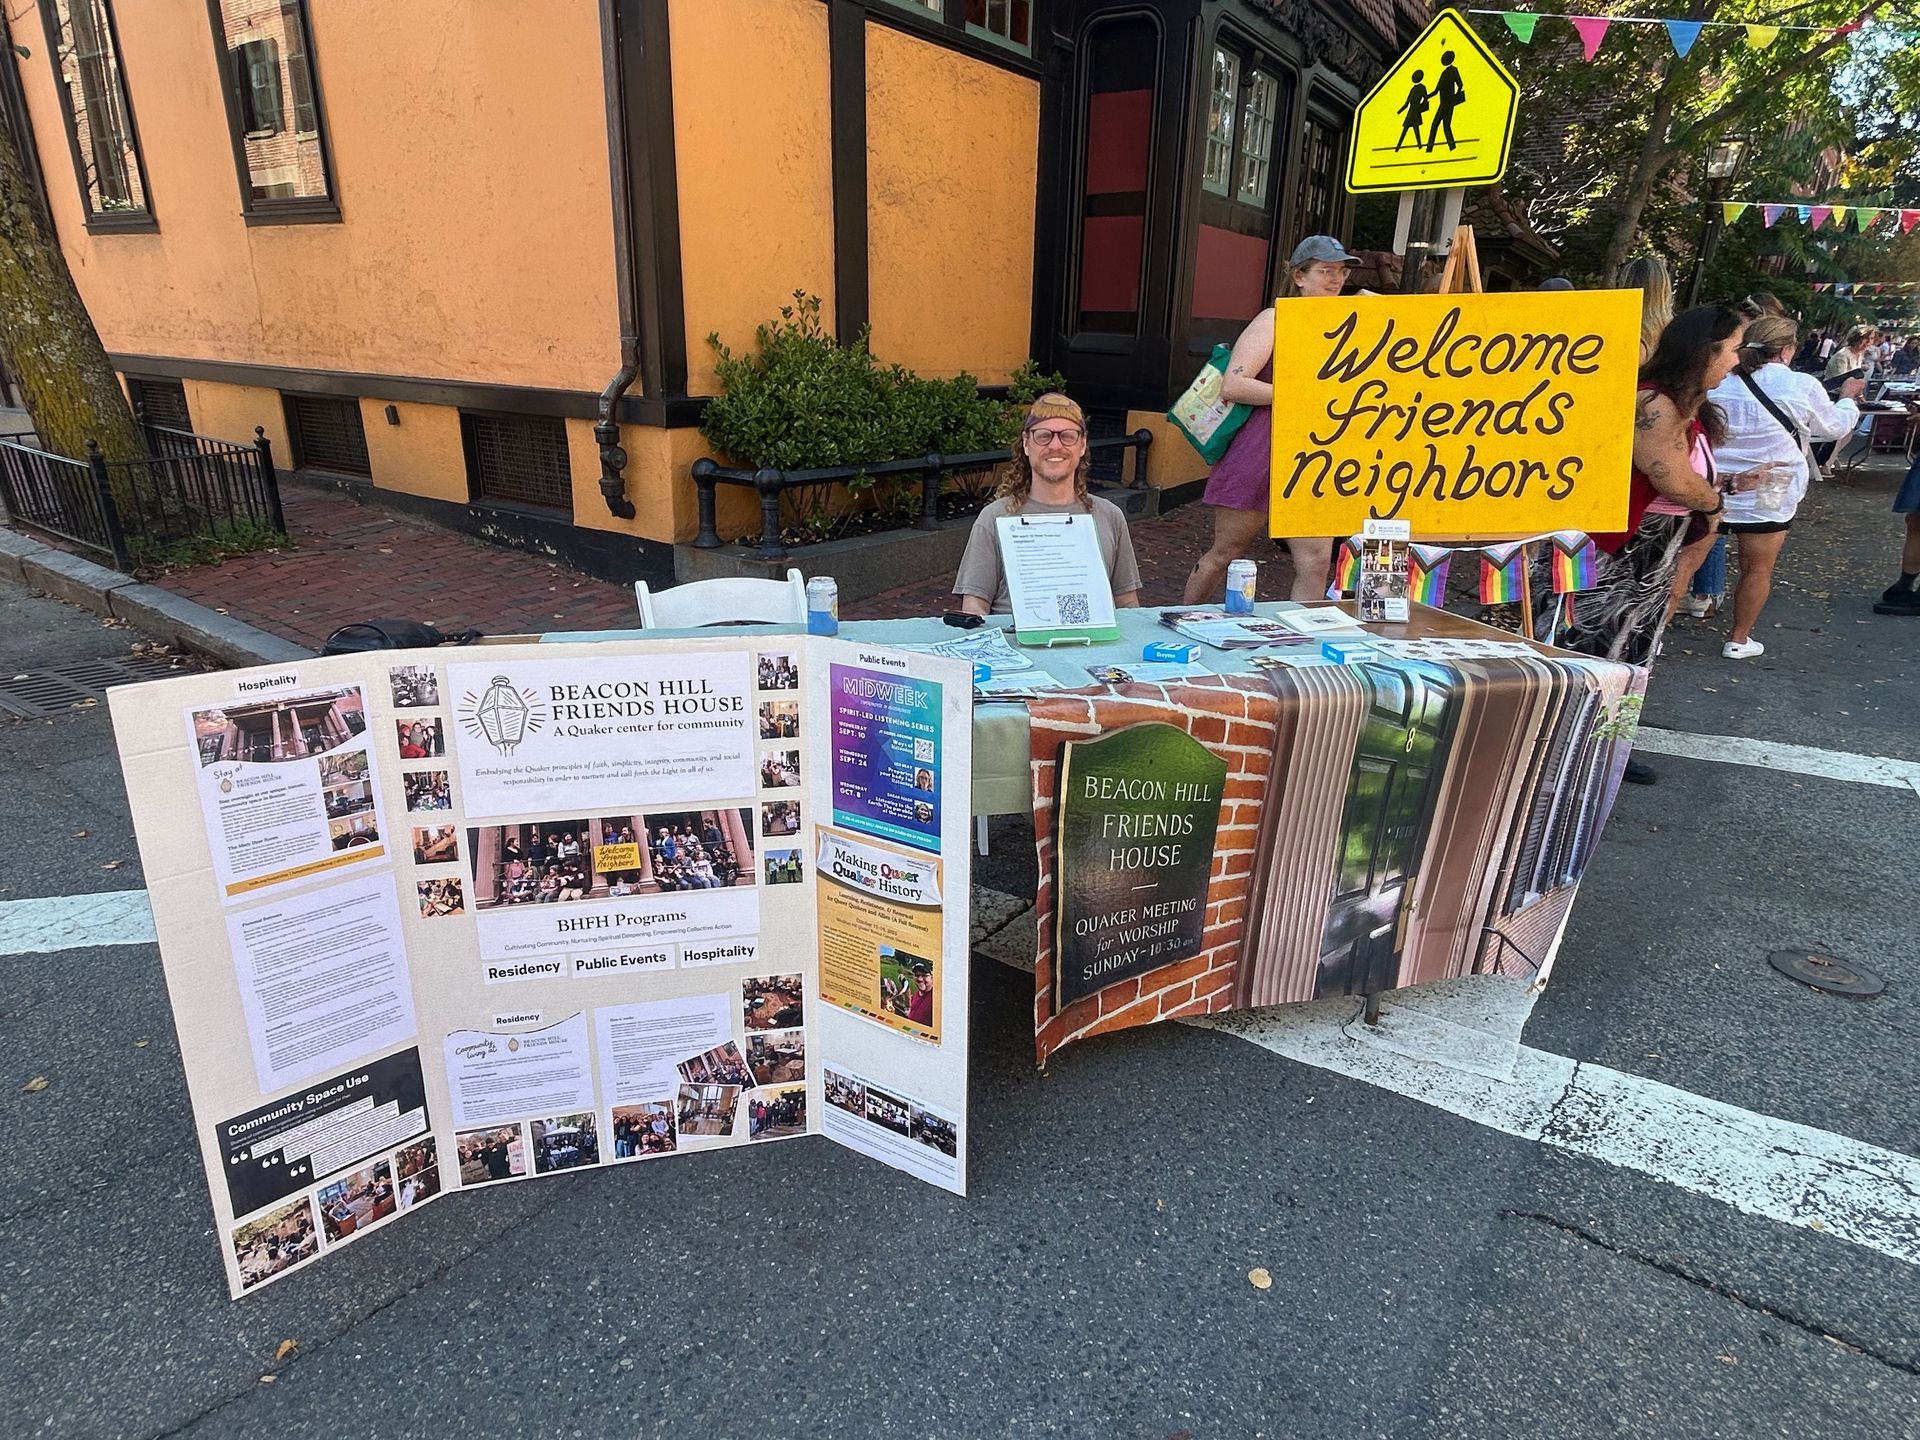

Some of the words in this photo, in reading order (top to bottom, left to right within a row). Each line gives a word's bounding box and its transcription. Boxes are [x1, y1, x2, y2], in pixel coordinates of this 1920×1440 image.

[1318, 307, 1604, 382] Welcome
[1309, 379, 1574, 446] friends
[1283, 444, 1583, 519] neighbors
[859, 654, 881, 665] Public
[882, 657, 906, 668] Events
[238, 674, 297, 692] Hospitality
[551, 680, 651, 701] BEACON
[660, 679, 714, 696] HILL
[843, 677, 928, 709] MIDWEEK
[552, 700, 655, 721] FRIENDS
[664, 696, 744, 715] HOUSE
[553, 726, 564, 737] A
[567, 722, 613, 737] Quaker
[616, 722, 653, 734] center
[656, 719, 674, 731] for
[677, 717, 745, 731] community
[839, 708, 874, 720] SPIRIT-LED
[875, 714, 910, 728] LISTENING
[911, 722, 934, 733] SERIES
[839, 728, 857, 736] SEPT.
[475, 768, 512, 776] Embodying
[525, 766, 550, 774] Quaker
[552, 763, 582, 772] principles
[840, 755, 857, 764] SEPT.
[214, 770, 233, 780] Stay
[503, 777, 545, 786] responsibility
[634, 770, 649, 778] forth
[840, 782, 867, 792] WEDNESDAY
[840, 788, 855, 797] OCT.
[1084, 776, 1167, 800] BEACON
[1175, 783, 1211, 802] HILL
[1102, 814, 1193, 838] FRIENDS
[835, 847, 877, 875] Making
[880, 864, 919, 883] Queer
[1110, 845, 1181, 871] HOUSE
[833, 862, 876, 888] Quaker
[879, 879, 922, 901] History
[556, 914, 610, 933] BHFH
[614, 908, 687, 929] Programs
[1076, 909, 1136, 936] QUAKER
[1143, 898, 1197, 919] MEETING
[504, 942, 536, 952] Cultivating
[571, 936, 597, 944] Nurturing
[1094, 937, 1114, 959] for
[1119, 919, 1179, 944] WORSHIP
[576, 955, 617, 971] Public
[620, 951, 666, 966] Events
[683, 944, 755, 964] Hospitality
[488, 960, 561, 980] Residency
[496, 1014, 540, 1025] Residency
[456, 1038, 495, 1055] Community
[467, 1051, 486, 1059] living
[228, 1100, 304, 1136] Community
[306, 1084, 344, 1104] Space
[346, 1074, 369, 1088] Use
